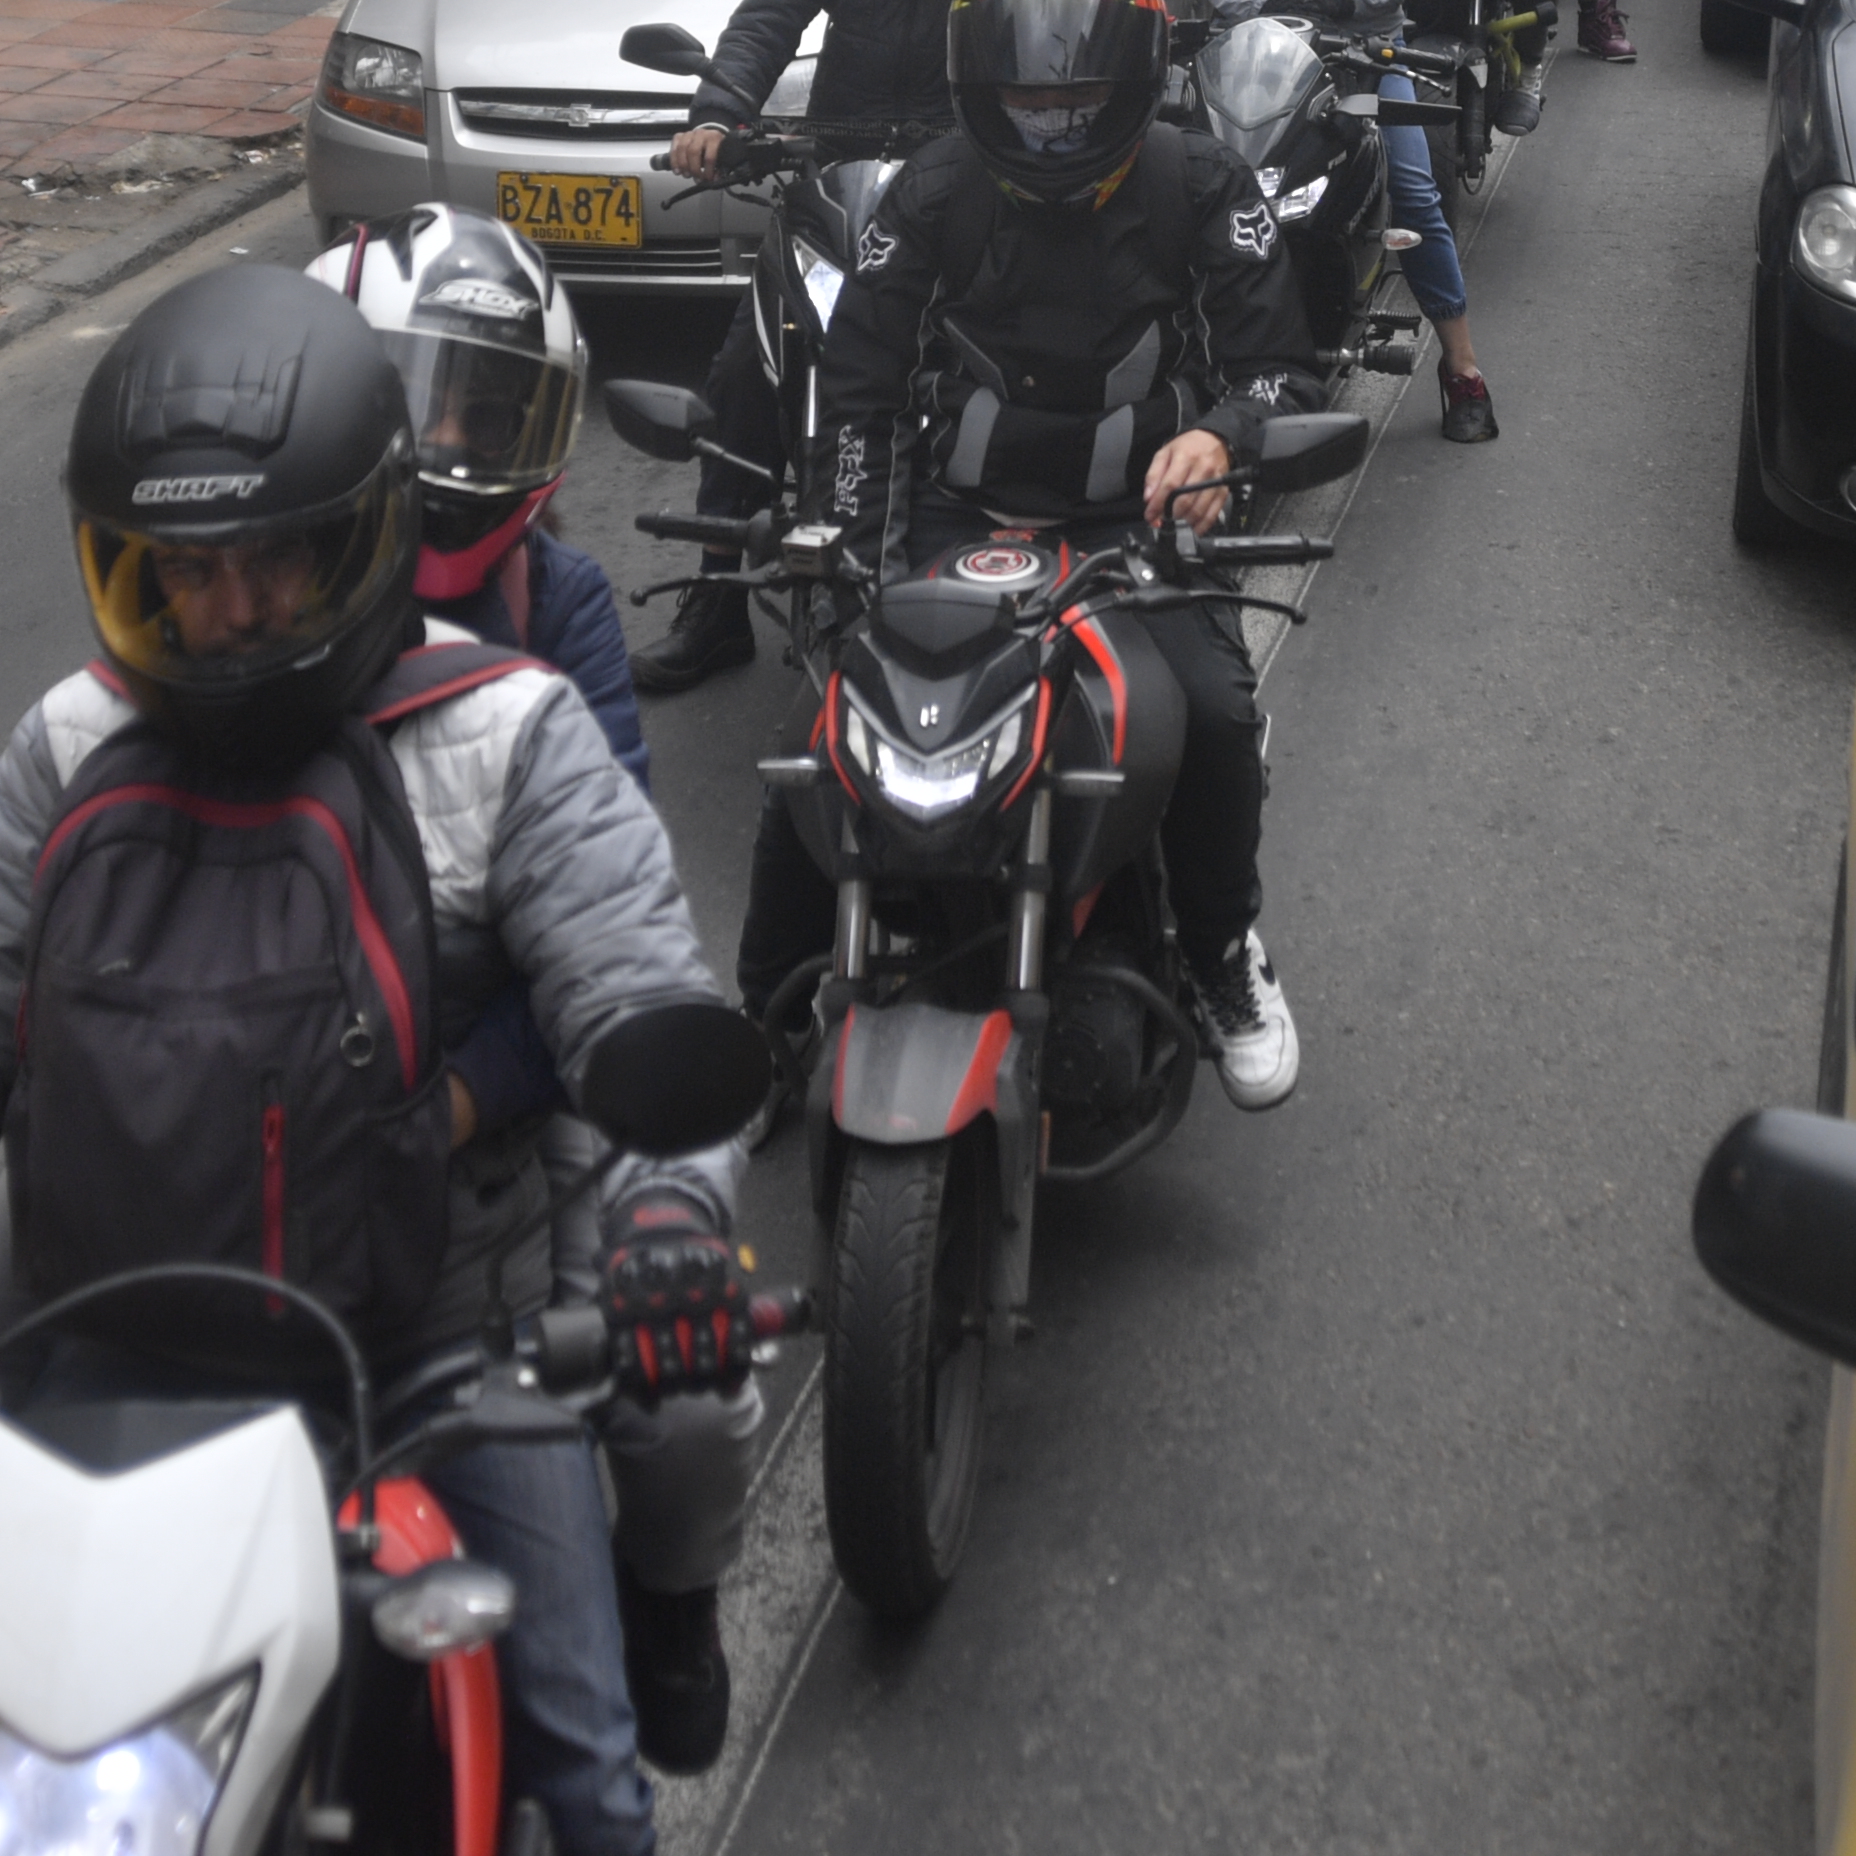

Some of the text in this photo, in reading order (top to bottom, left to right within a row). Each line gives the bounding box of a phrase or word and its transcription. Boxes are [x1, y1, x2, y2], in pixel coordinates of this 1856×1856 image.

[500, 184, 635, 228] BZA 874
[531, 227, 577, 242] BOGOTA
[131, 473, 266, 505] SHAFT
